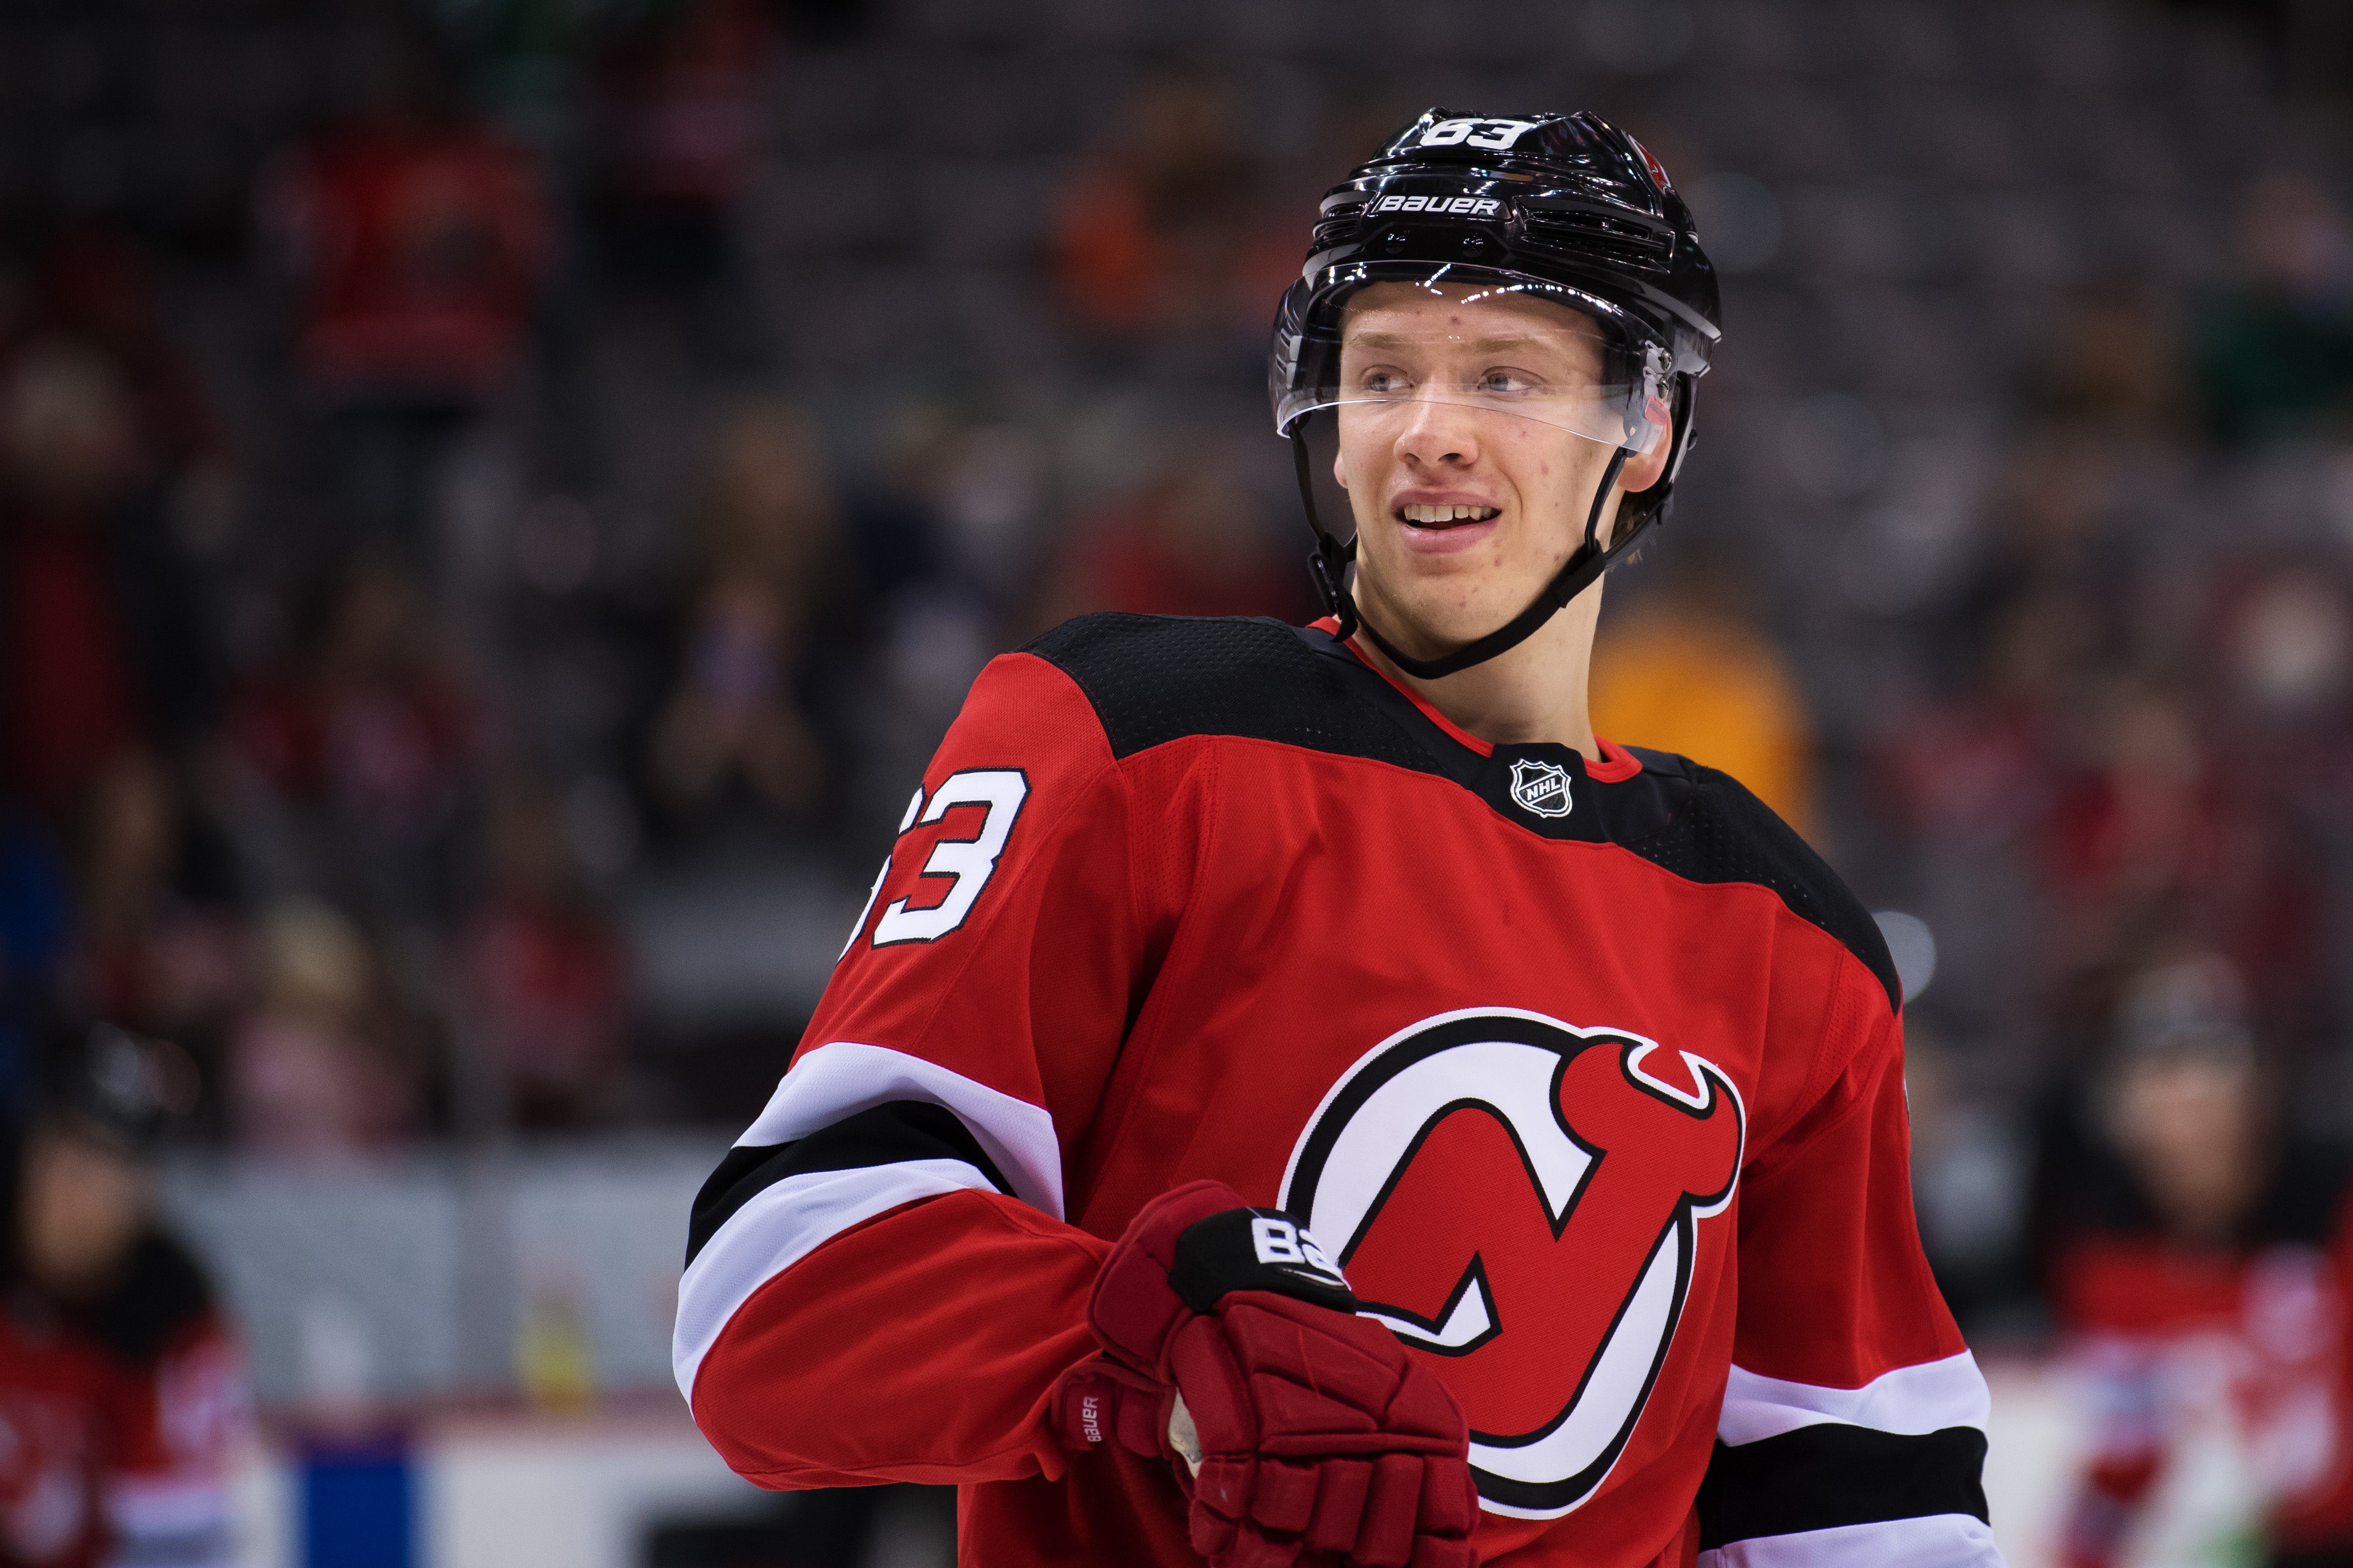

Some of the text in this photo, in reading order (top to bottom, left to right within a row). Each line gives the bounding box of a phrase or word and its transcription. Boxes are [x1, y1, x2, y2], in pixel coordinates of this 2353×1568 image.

[1419, 118, 1534, 150] 63
[1379, 196, 1501, 216] BAUER
[1526, 778, 1561, 801] NHL
[835, 766, 1032, 967] 3
[1082, 1396, 1102, 1442] BAUER
